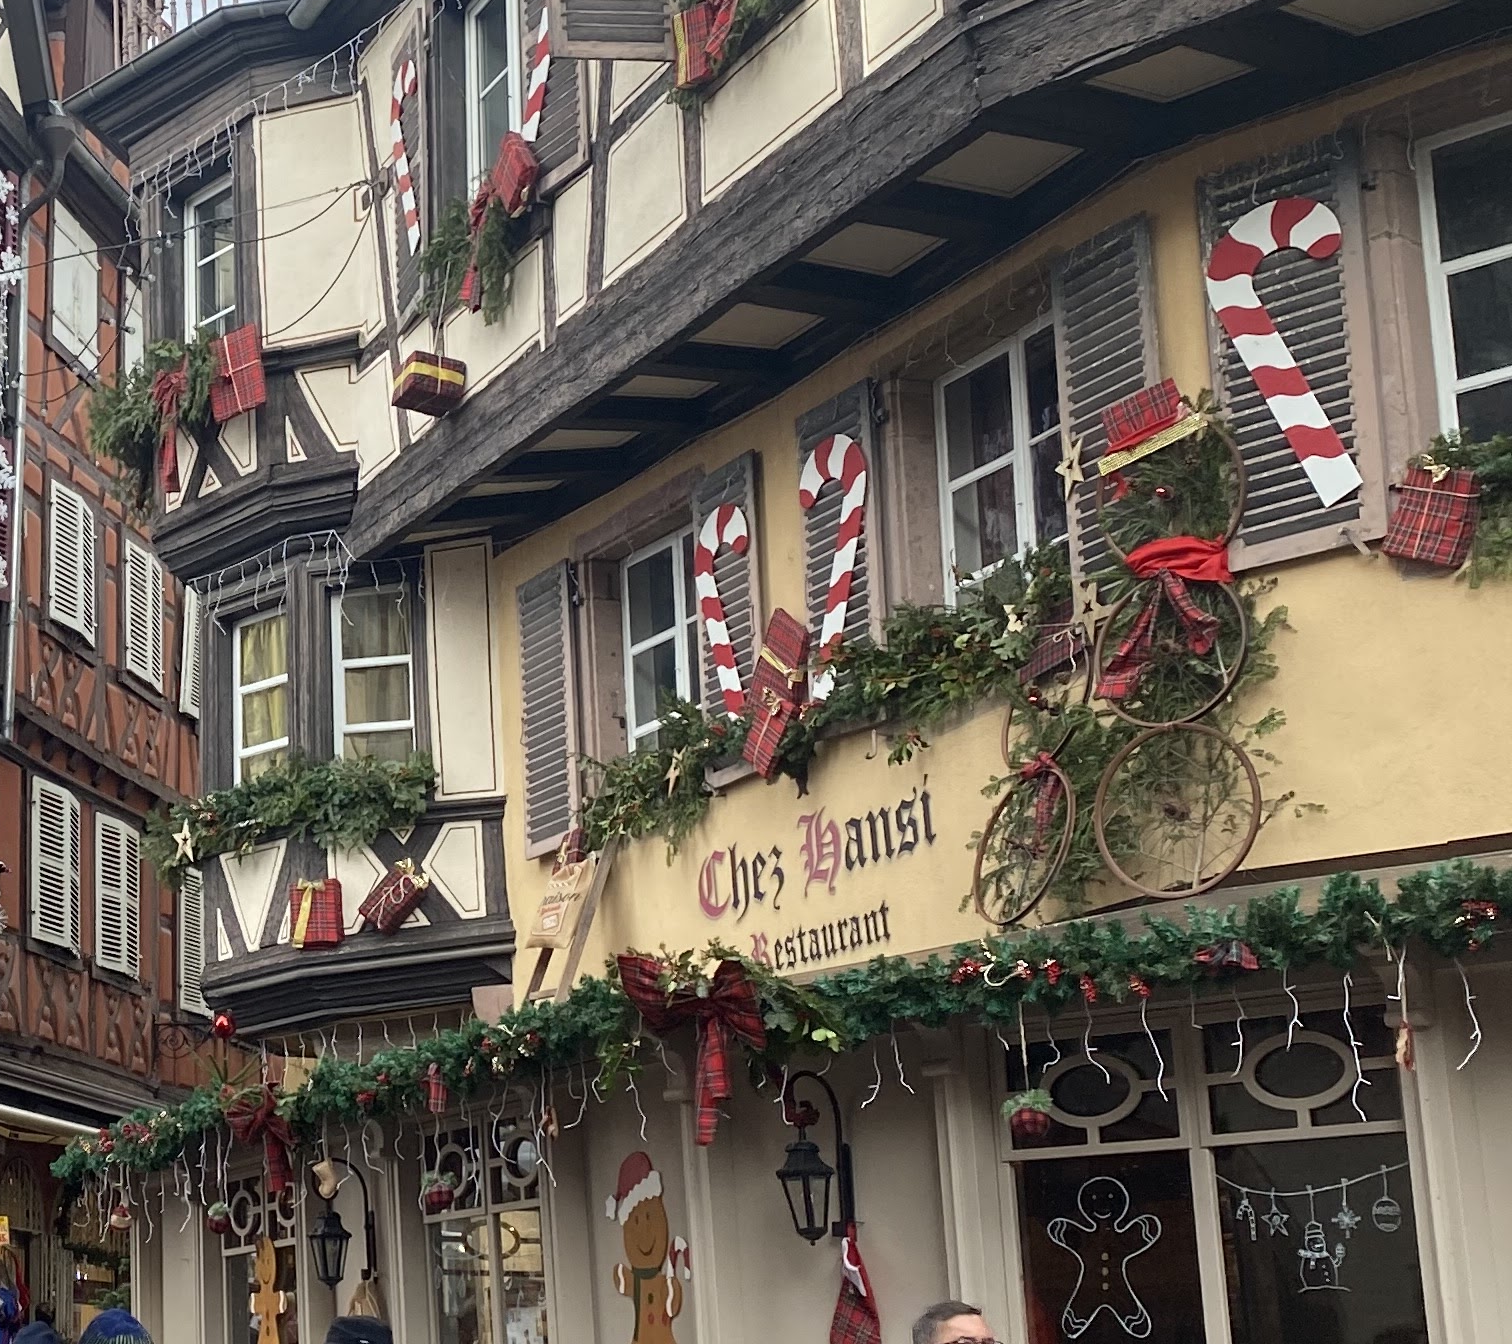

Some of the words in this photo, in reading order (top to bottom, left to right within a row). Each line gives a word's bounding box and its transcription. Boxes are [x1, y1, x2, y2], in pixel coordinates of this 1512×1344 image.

[698, 841, 785, 921] Chez
[797, 773, 937, 899] Hansi
[750, 900, 891, 971] Restaurant
